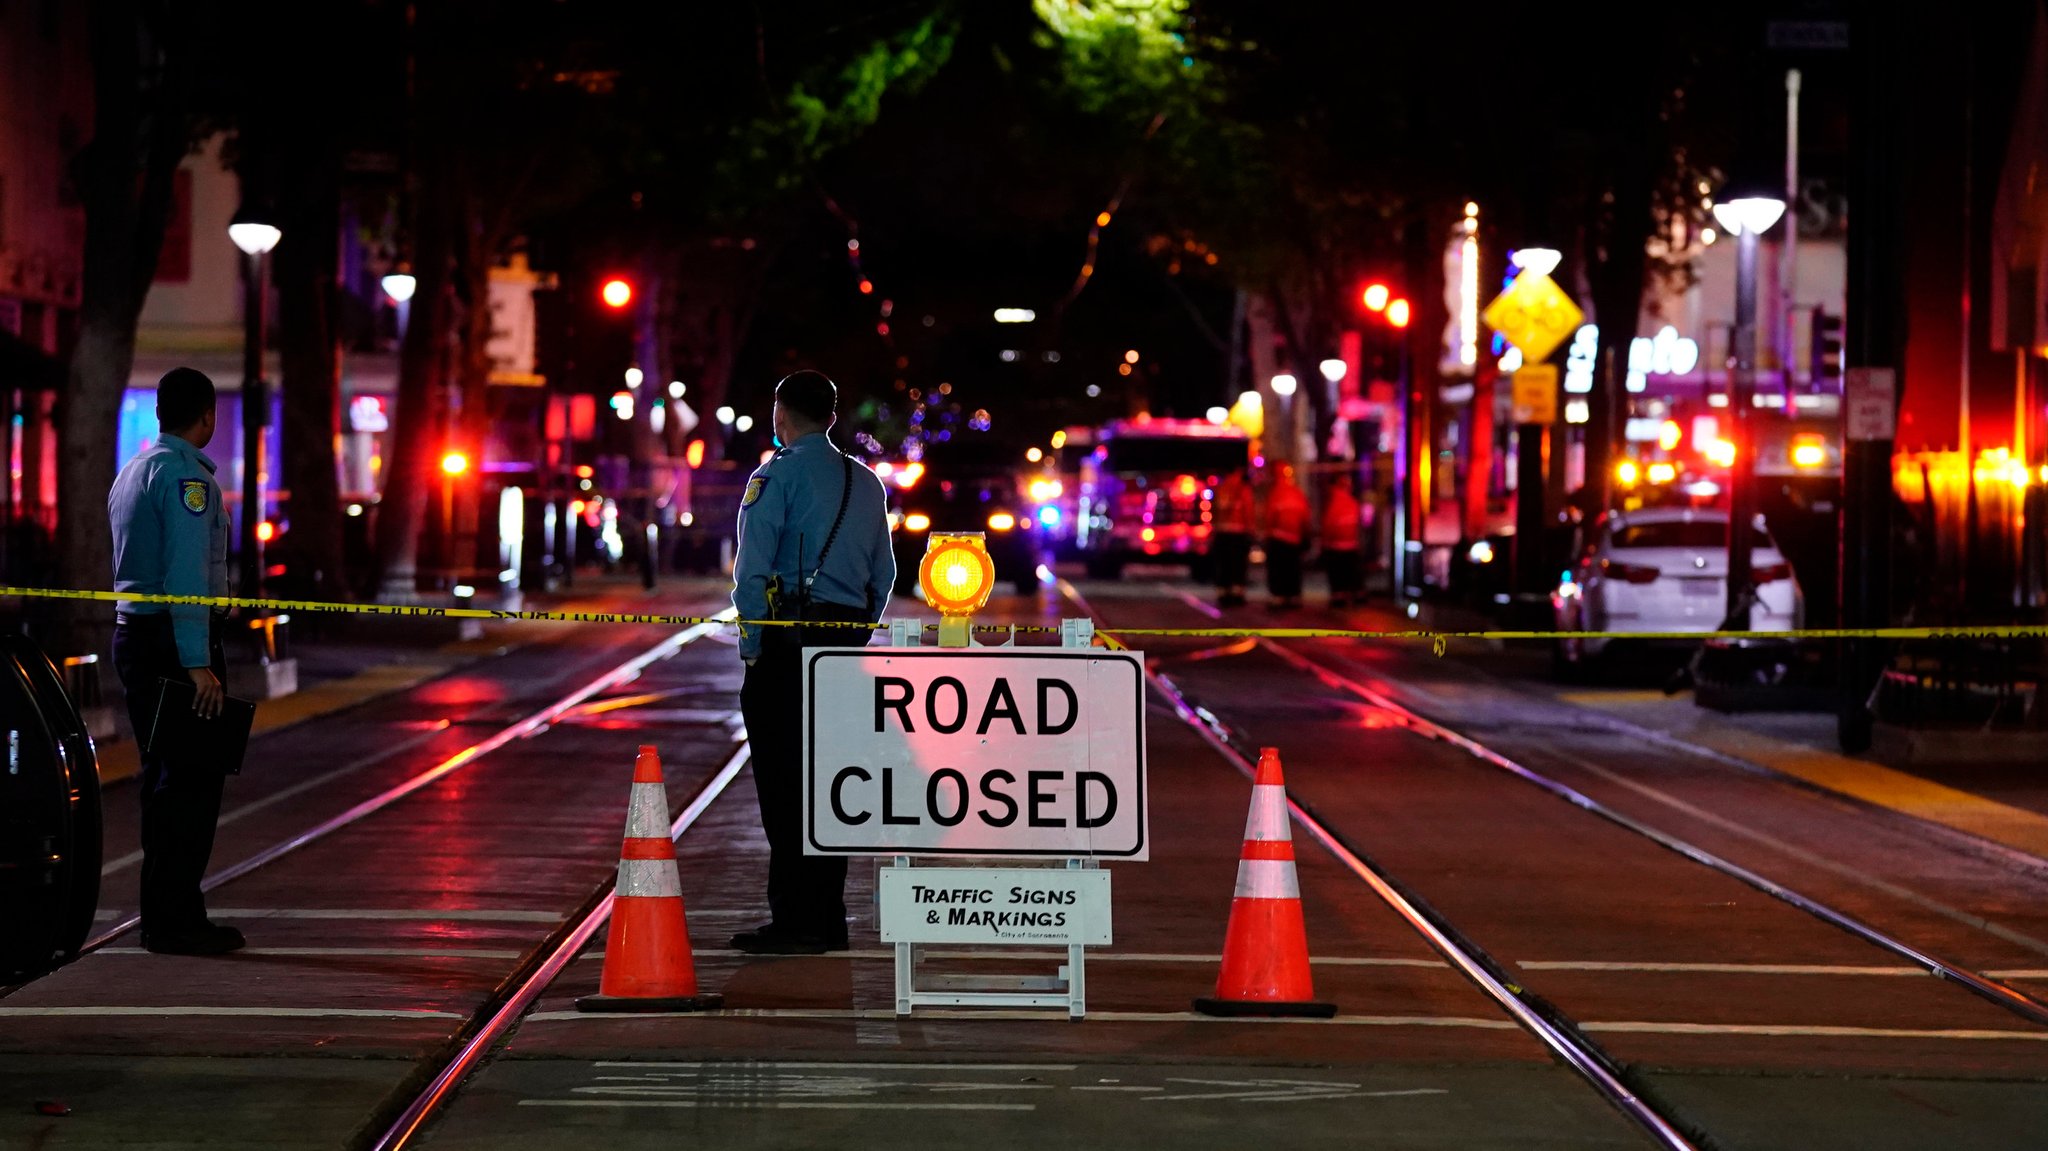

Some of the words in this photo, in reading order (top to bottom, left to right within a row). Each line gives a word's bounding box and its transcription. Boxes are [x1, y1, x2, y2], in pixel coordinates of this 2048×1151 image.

[874, 676, 1079, 736] ROAD
[830, 766, 1118, 828] CLOSED
[926, 909, 940, 924] &
[1001, 931, 1015, 939] City
[1028, 931, 1069, 939] Sacramento
